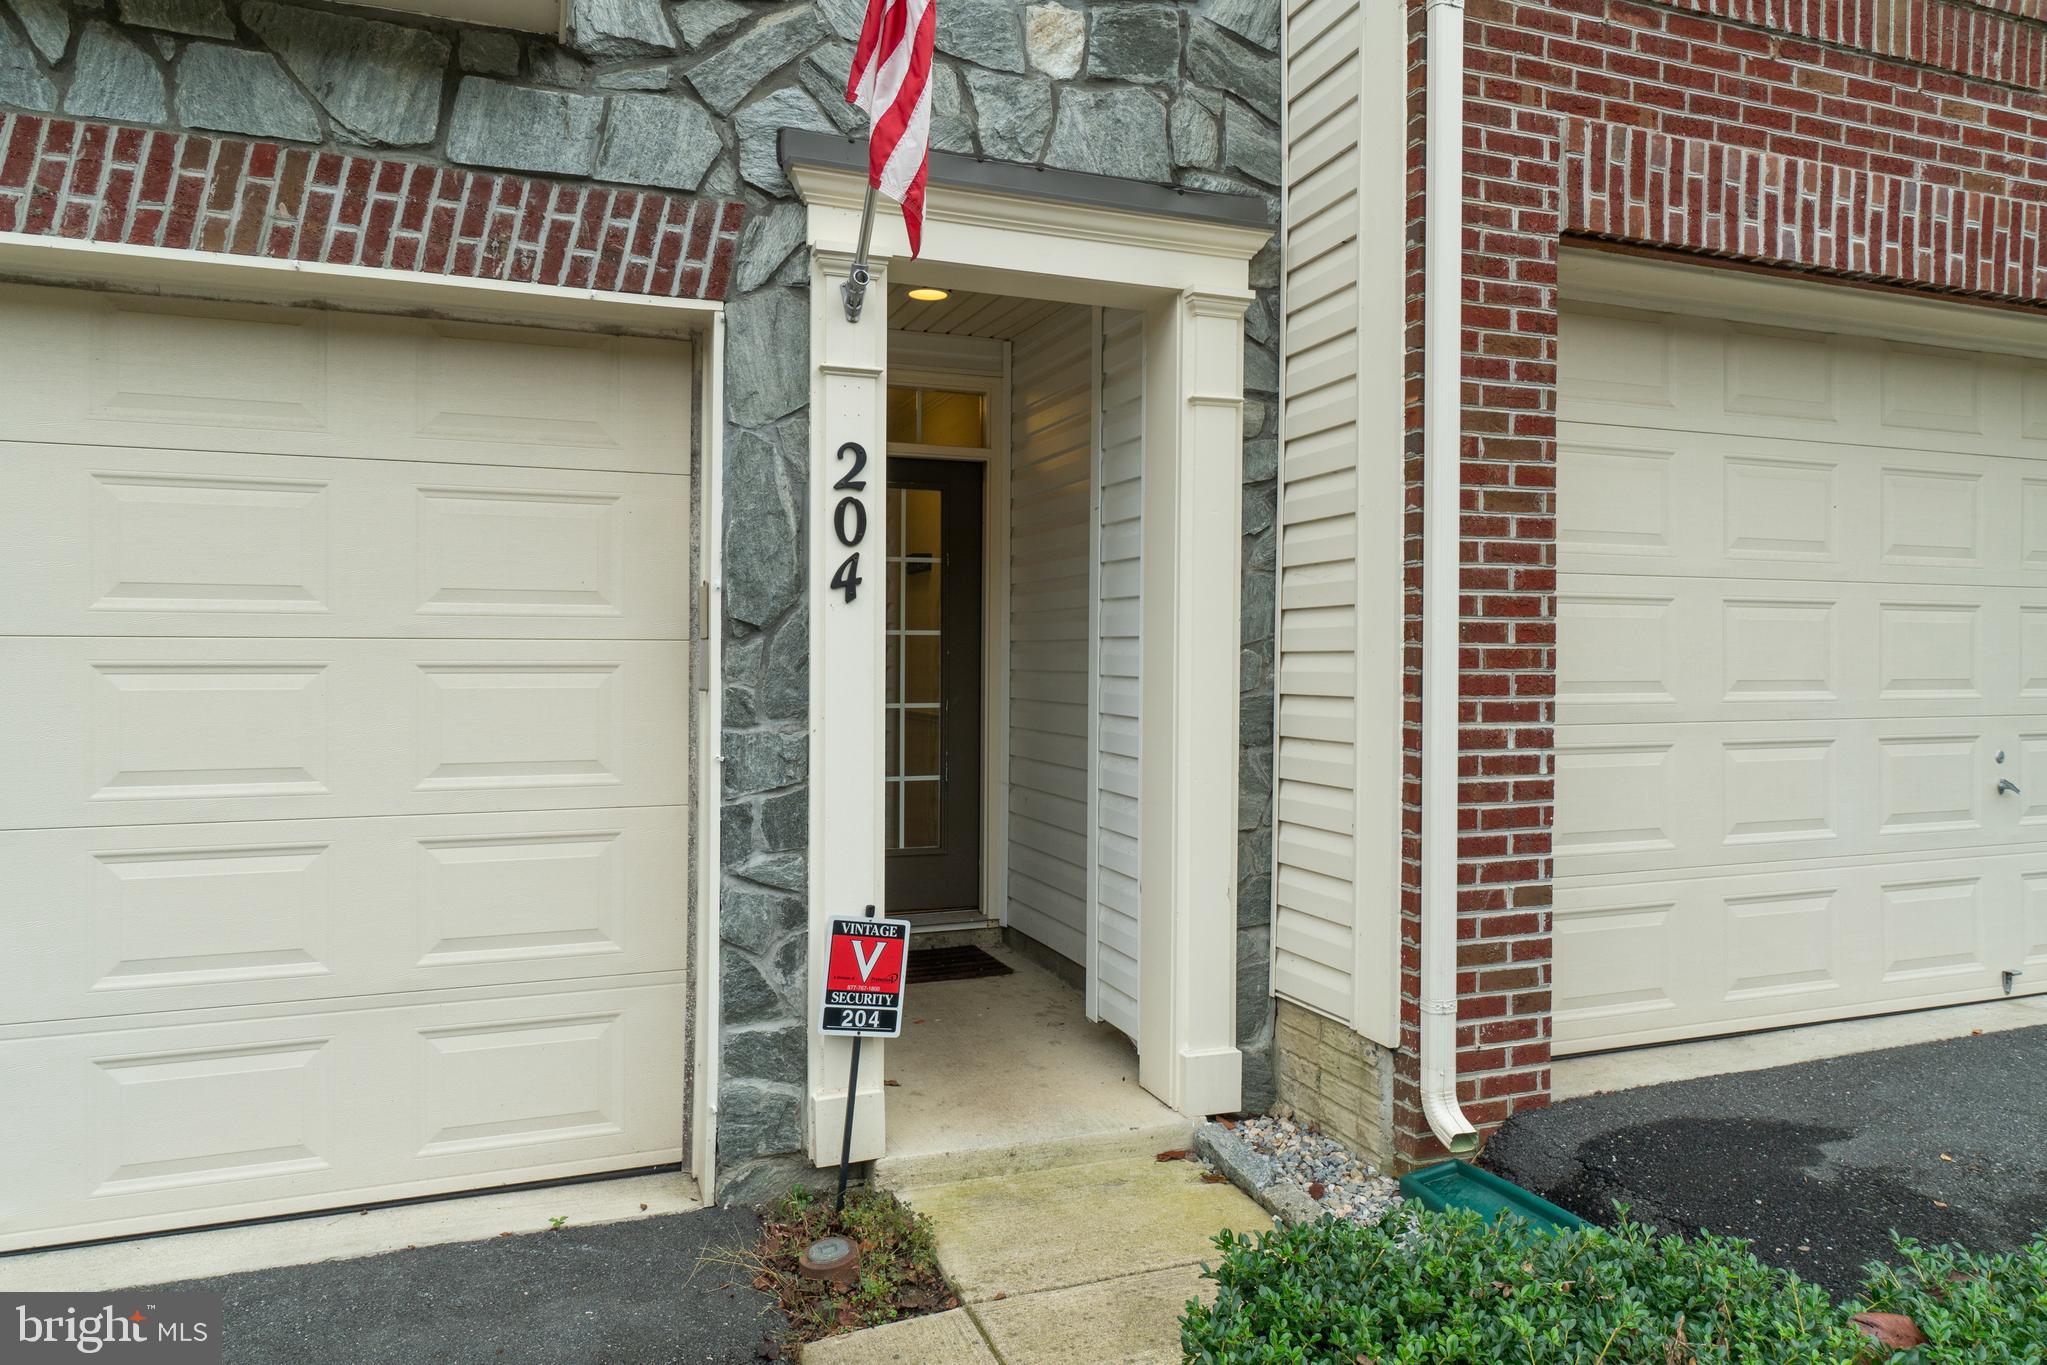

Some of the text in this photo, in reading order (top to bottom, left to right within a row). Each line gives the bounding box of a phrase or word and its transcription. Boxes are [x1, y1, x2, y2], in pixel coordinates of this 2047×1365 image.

[830, 441, 868, 604] 204
[841, 922, 898, 938] VINTAGE
[851, 939, 888, 985] V
[831, 992, 894, 1006] SECURITY
[841, 1009, 880, 1028] 204
